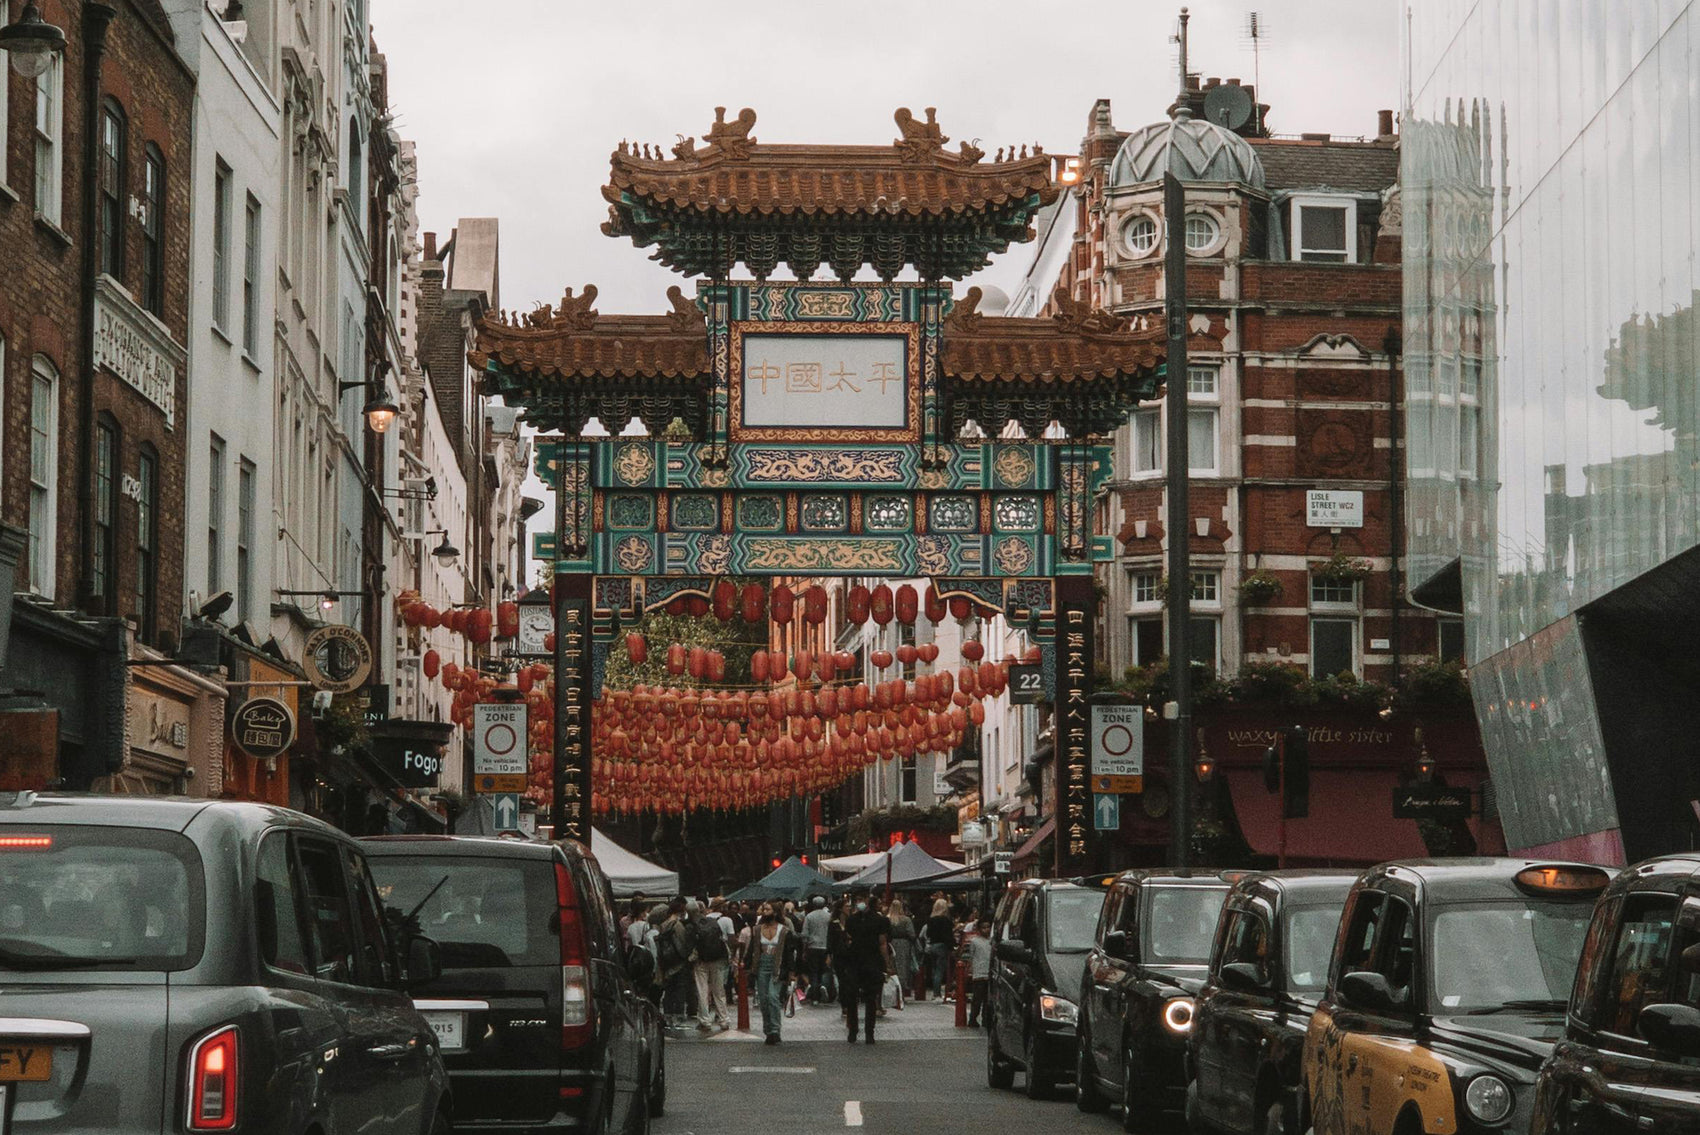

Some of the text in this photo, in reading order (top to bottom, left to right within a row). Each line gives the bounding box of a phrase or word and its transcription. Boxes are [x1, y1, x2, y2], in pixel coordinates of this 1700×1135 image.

[748, 358, 901, 395] 中國太平
[1311, 492, 1330, 501] LISLE
[1311, 501, 1355, 510] STREET WC2
[1020, 673, 1042, 689] 22
[249, 710, 281, 722] Bake
[485, 713, 516, 722] ZONE
[1101, 714, 1132, 724] ZONE
[1306, 726, 1342, 743] ittle
[1349, 727, 1393, 743] sister
[404, 751, 438, 776] Fogo
[499, 764, 509, 772] 10
[510, 765, 523, 773] pm
[1115, 765, 1126, 773] 10
[1126, 766, 1139, 774] pm
[431, 1023, 454, 1033] 915
[0, 1048, 34, 1075] FY
